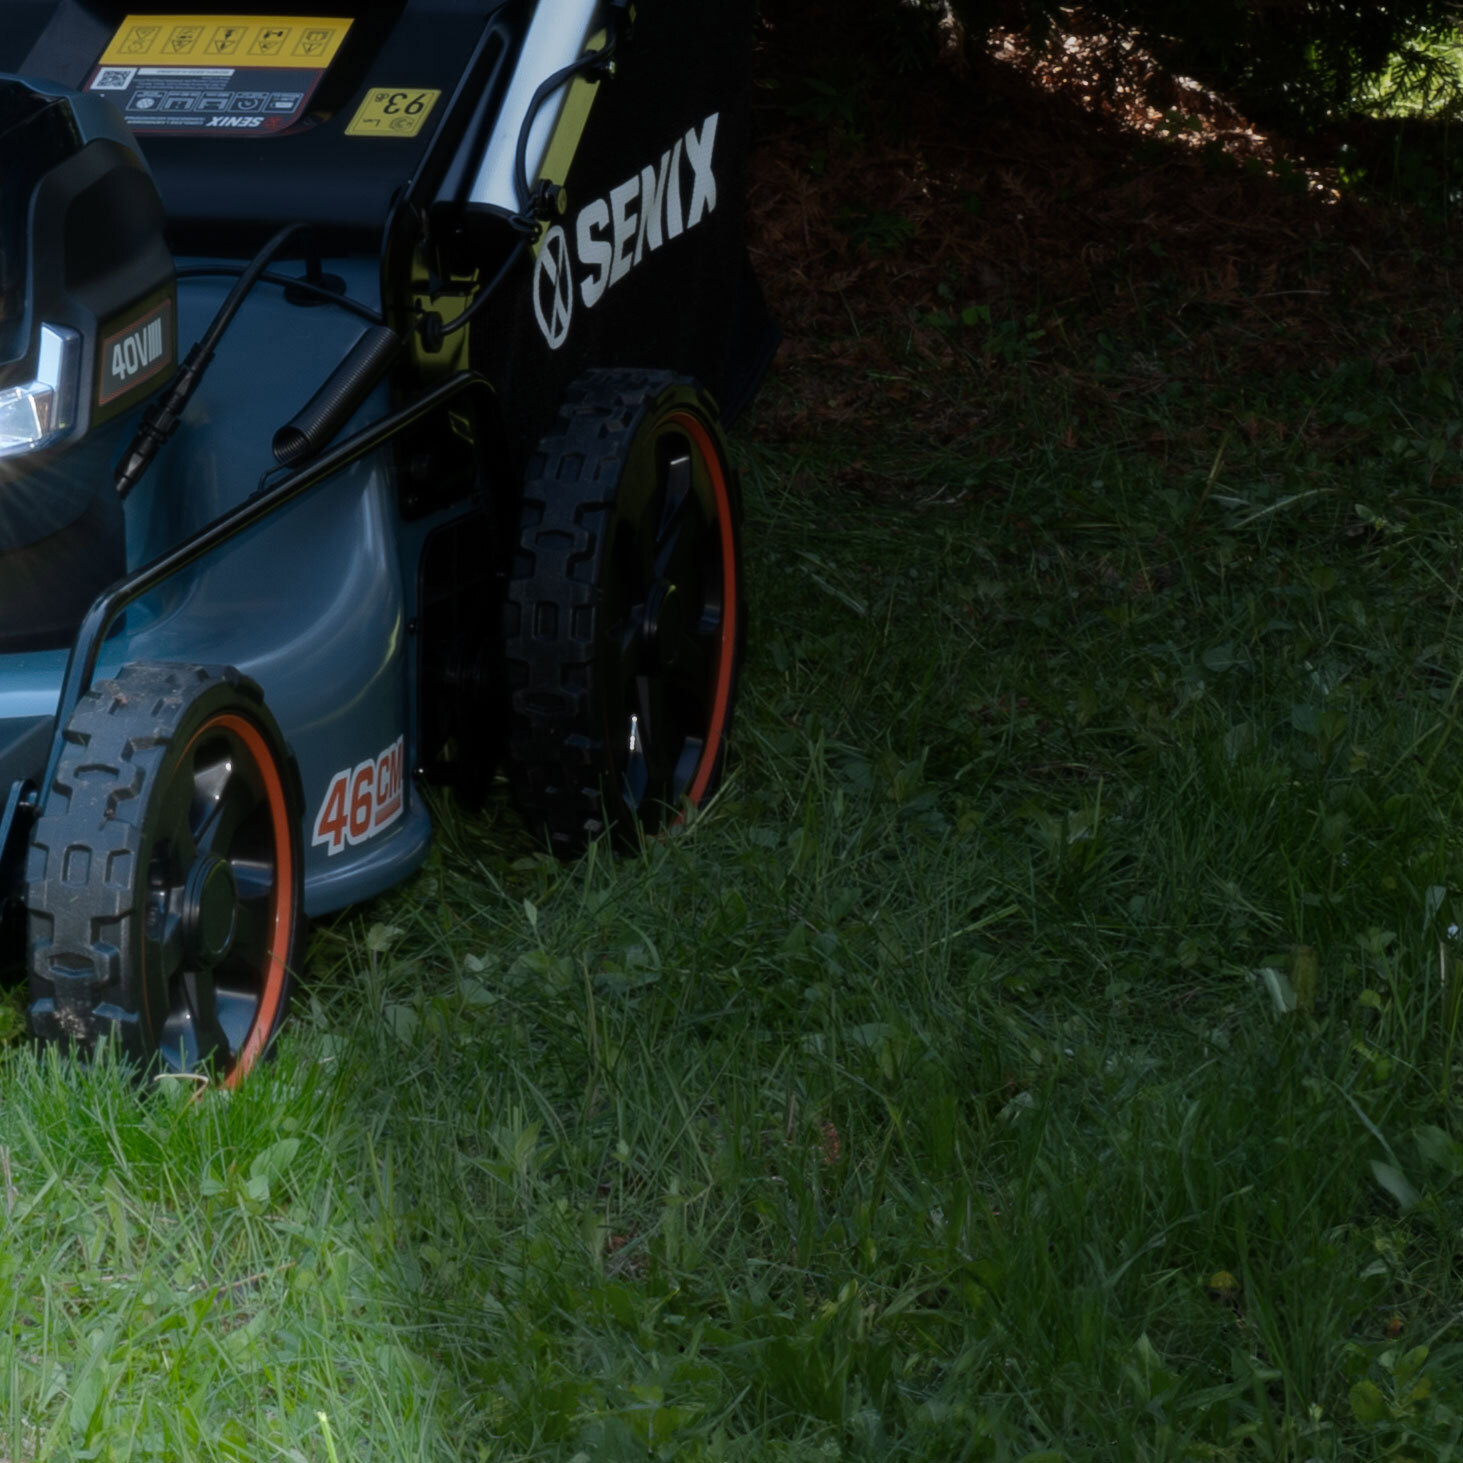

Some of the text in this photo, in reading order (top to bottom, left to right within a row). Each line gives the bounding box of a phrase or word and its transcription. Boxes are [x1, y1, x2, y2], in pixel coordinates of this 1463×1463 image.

[384, 93, 426, 115] 93
[205, 116, 265, 128] SENIX
[576, 111, 720, 308] SENIX
